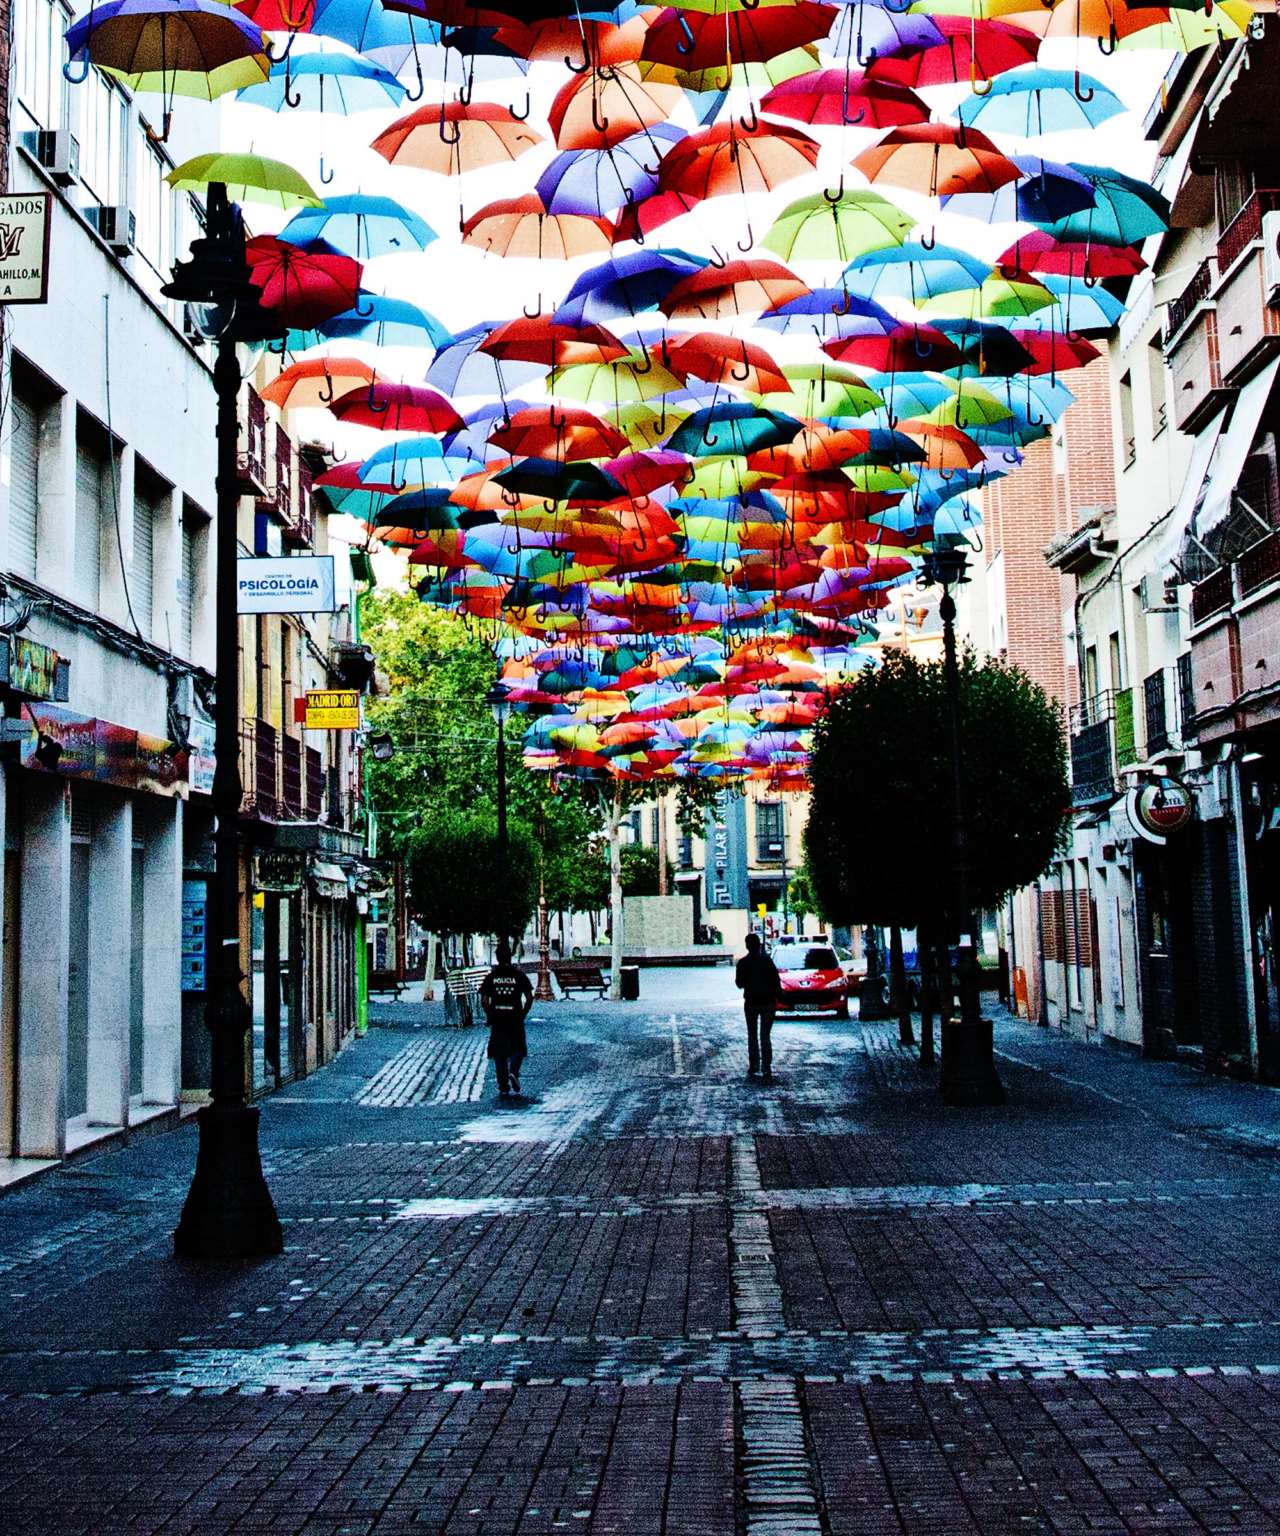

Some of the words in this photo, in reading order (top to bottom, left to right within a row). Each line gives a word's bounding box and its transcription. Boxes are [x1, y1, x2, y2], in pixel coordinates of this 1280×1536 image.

[4, 285, 12, 295] A
[239, 576, 319, 590] PSICOLOGÍA
[715, 832, 729, 868] PILAR
